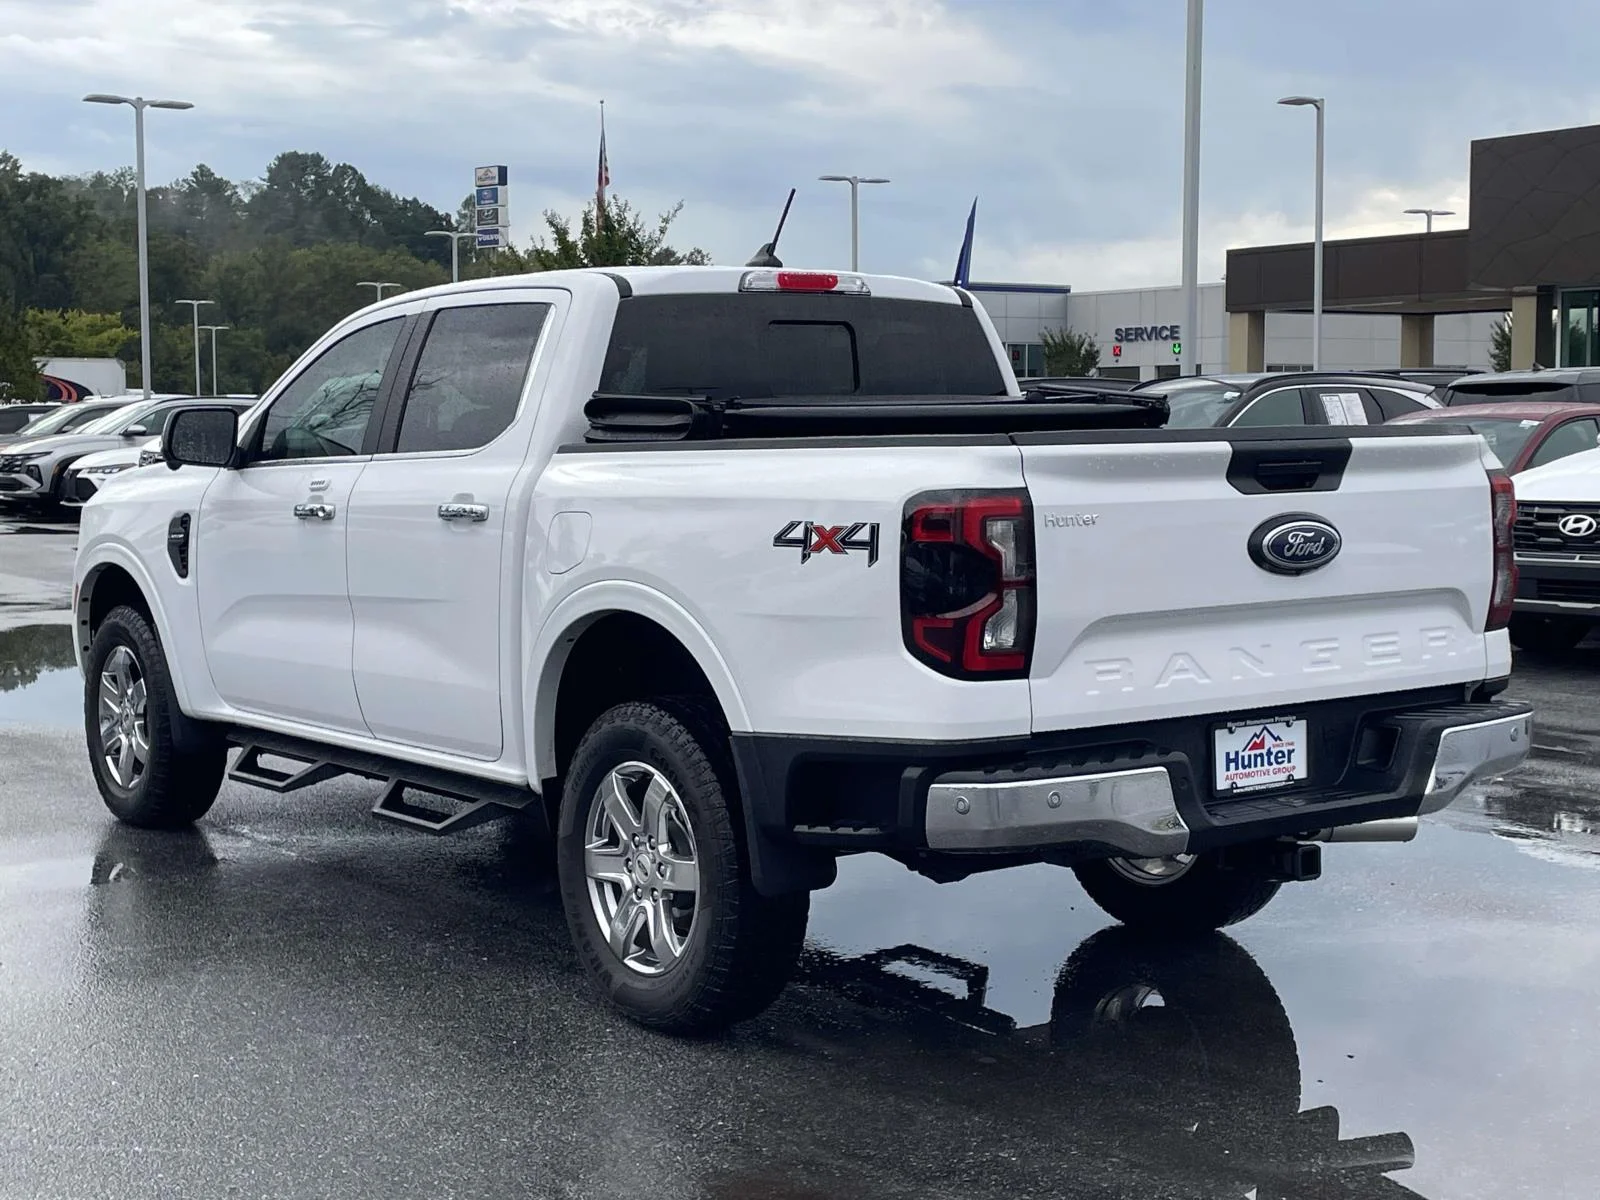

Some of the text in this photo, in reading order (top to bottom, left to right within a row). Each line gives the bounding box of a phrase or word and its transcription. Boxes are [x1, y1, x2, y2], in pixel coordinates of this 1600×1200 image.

[1114, 325, 1180, 342] SERVICE
[1043, 512, 1100, 528] Hunter
[1283, 531, 1326, 557] Ford
[1083, 624, 1457, 696] RANGER
[1225, 746, 1296, 772] Hunter
[1224, 765, 1297, 781] AUTOMOTIVE GROUP
